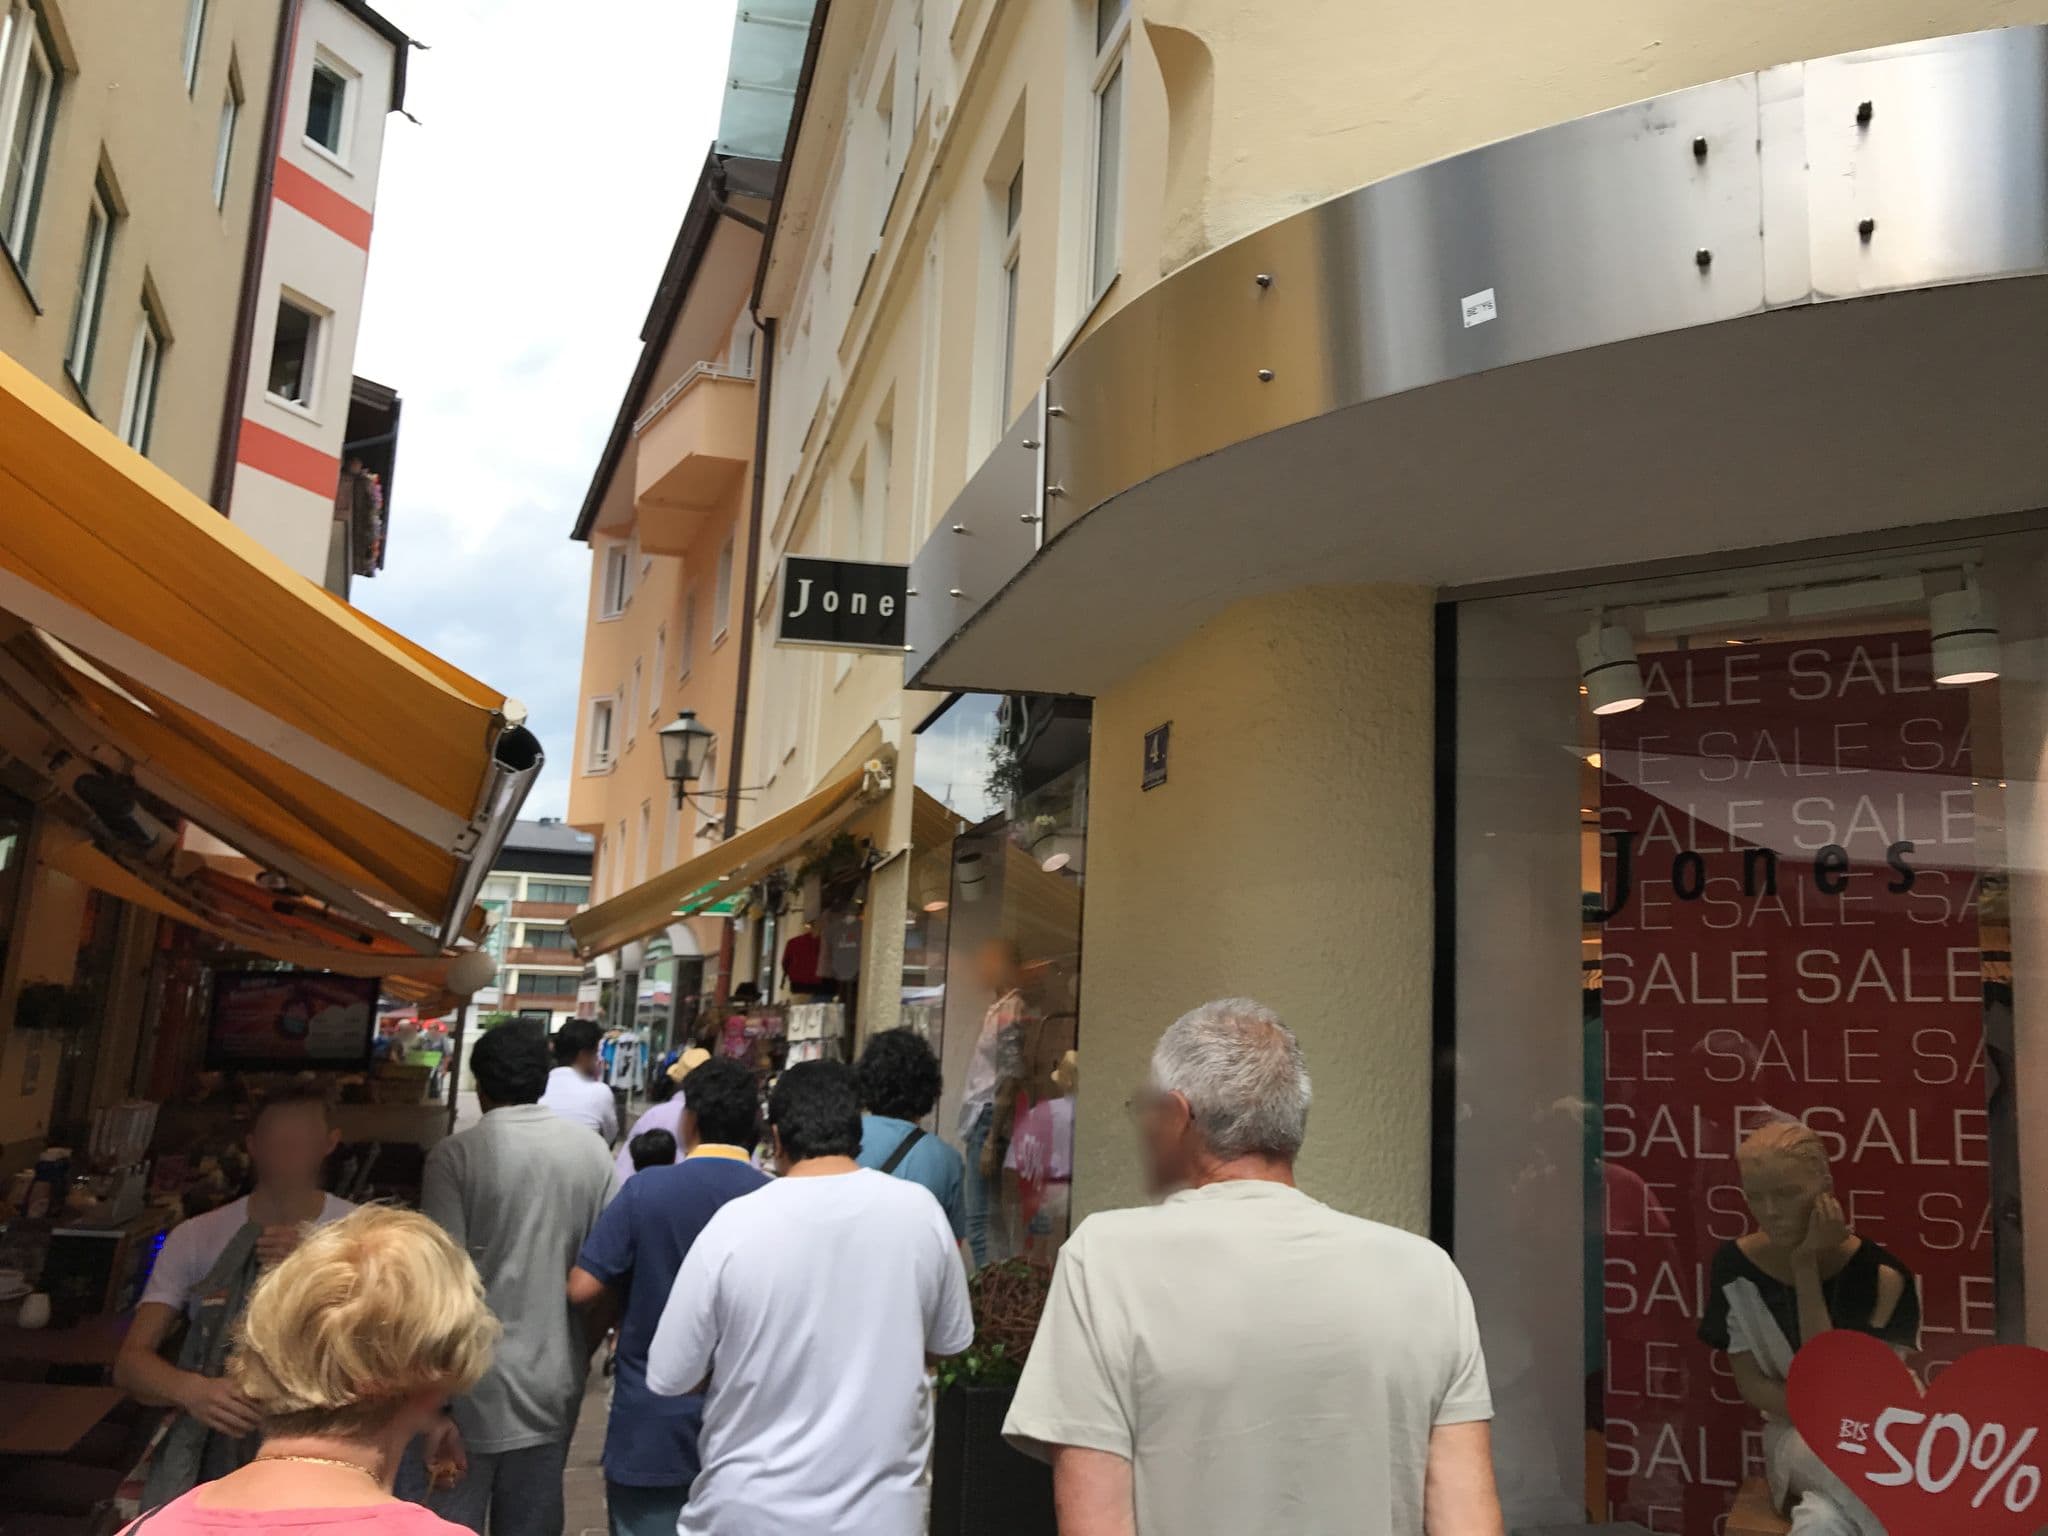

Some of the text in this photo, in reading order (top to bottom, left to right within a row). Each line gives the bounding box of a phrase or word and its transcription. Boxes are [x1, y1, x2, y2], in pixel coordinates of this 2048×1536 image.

[787, 578, 895, 618] Jone
[1645, 641, 1969, 710] ALE SAL
[1602, 735, 1672, 787] LE
[1699, 721, 1869, 782] SALE
[1600, 790, 1976, 858] SALE SALE
[1582, 831, 1915, 922] Jones
[1603, 880, 1673, 931] LE
[1702, 872, 1877, 930] SALE
[1602, 946, 1985, 1006] SALE SALE
[1605, 1029, 1676, 1082] LE
[1704, 1028, 1882, 1084] SALE
[1801, 1105, 1991, 1167] SALE
[1606, 1183, 1679, 1238] LE
[1914, 1273, 1995, 1336] LE
[1607, 1339, 1681, 1399] LE
[1839, 1418, 1870, 1441] BIS
